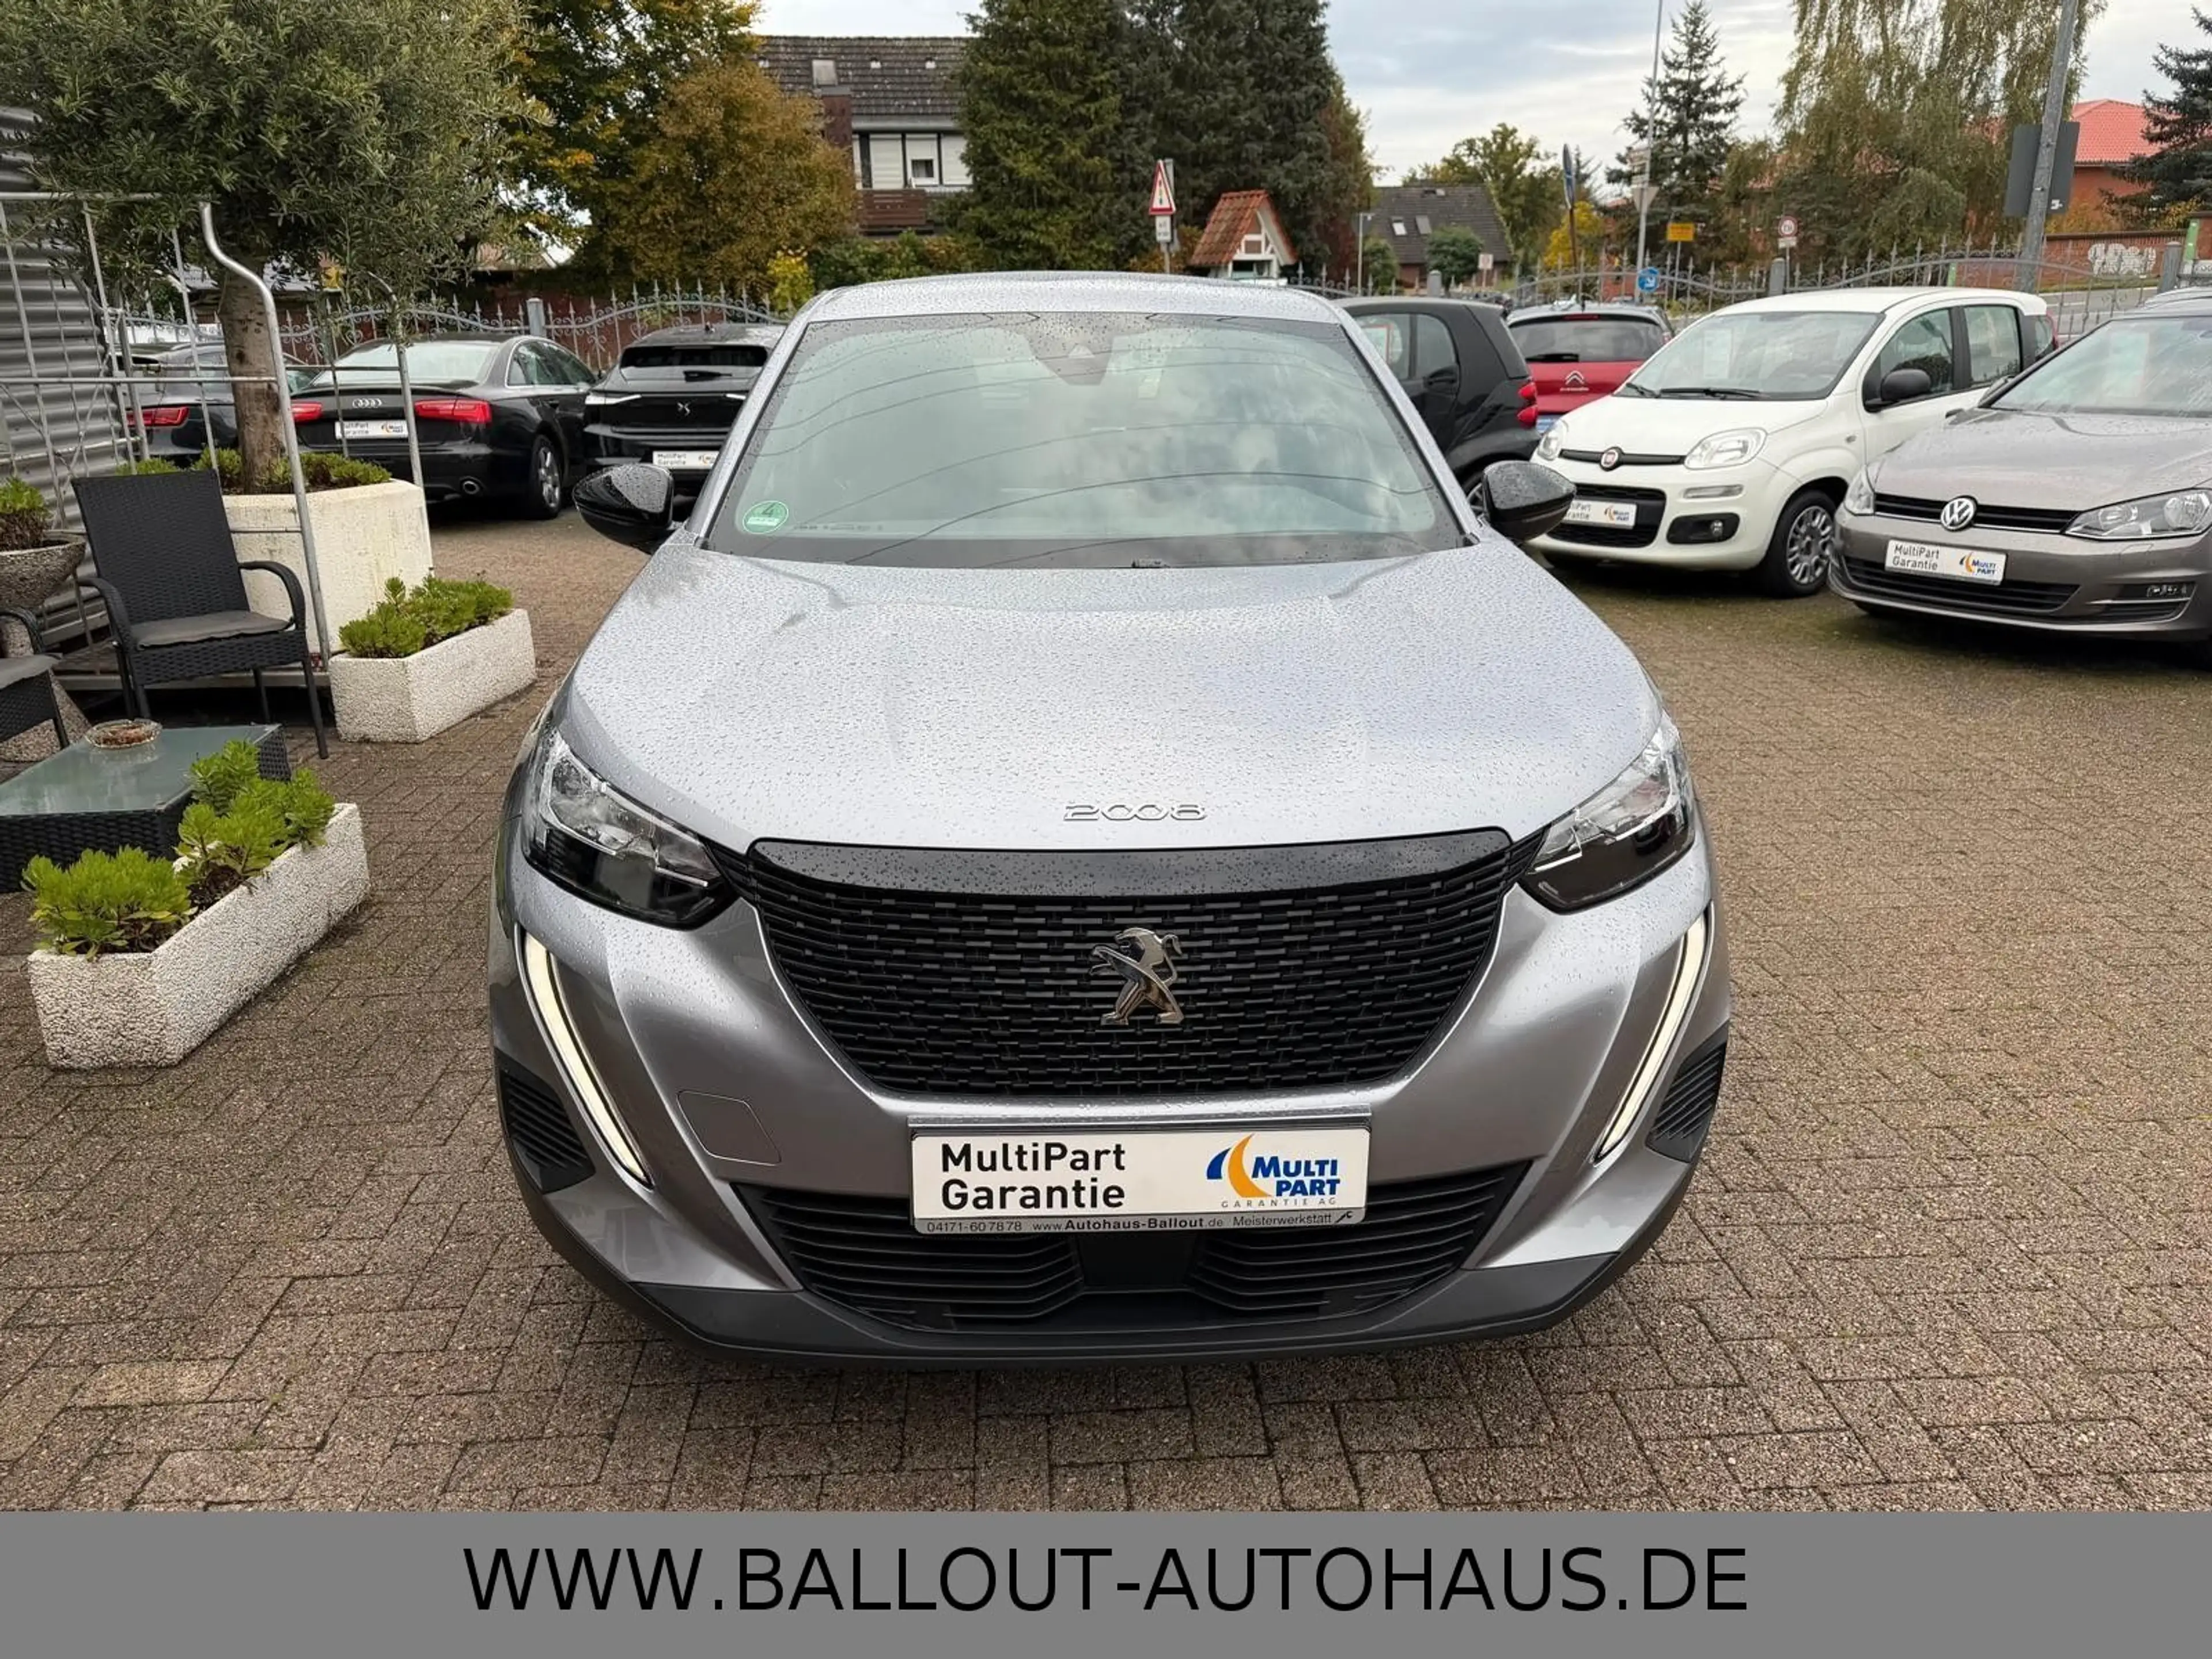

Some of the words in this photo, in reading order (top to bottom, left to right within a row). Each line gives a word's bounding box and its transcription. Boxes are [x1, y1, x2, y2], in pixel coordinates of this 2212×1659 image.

[1893, 544, 1940, 559] MultiPart
[1892, 555, 1938, 570] Garantie
[1063, 804, 1207, 821] 2008
[942, 1142, 1126, 1172] MultiPart
[1251, 1156, 1338, 1179] MULTI
[941, 1177, 1125, 1210] Garantie
[1275, 1179, 1341, 1196] PART
[1221, 1198, 1308, 1209] GARANTIE
[1319, 1197, 1336, 1205] AG
[1233, 1214, 1332, 1226] Meisterwerkstatt
